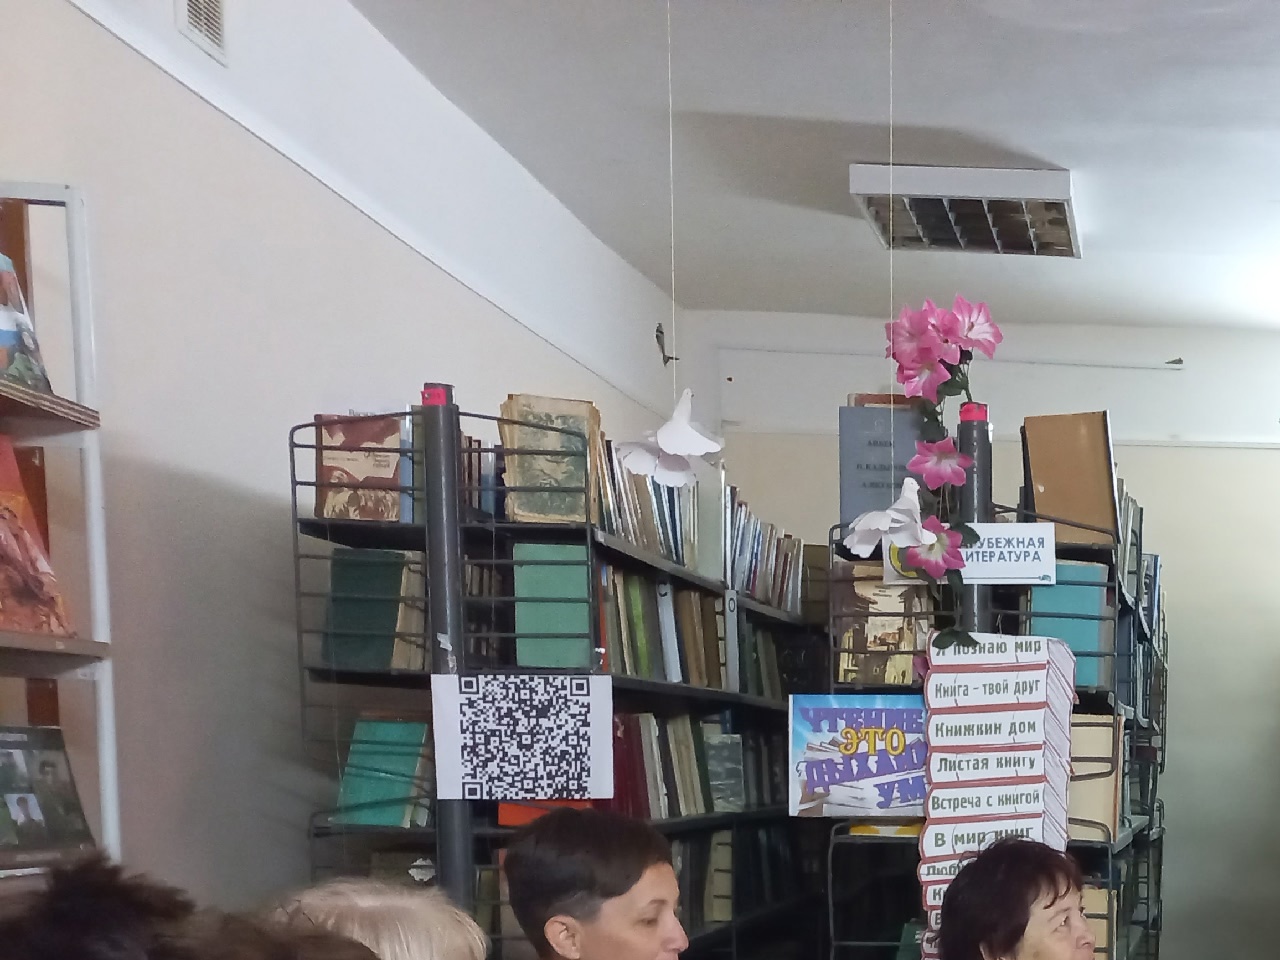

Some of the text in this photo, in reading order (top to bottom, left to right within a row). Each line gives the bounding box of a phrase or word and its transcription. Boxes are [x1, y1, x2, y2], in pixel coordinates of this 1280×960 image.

[961, 537, 1045, 549] УБЕЖНАЯ
[965, 550, 1042, 562] ИТЕРАТУРА
[1014, 639, 1042, 655] мир
[935, 682, 969, 698] Книга
[982, 679, 1009, 696] твой
[1014, 679, 1041, 696] друг
[935, 720, 1036, 738] Книжкин дом
[838, 727, 906, 756] ЭТО
[937, 756, 1036, 772] Листая книгу
[873, 775, 927, 809] УМ
[931, 789, 1040, 812] Встреча с книгой
[934, 832, 946, 848] В
[954, 831, 986, 850] мир
